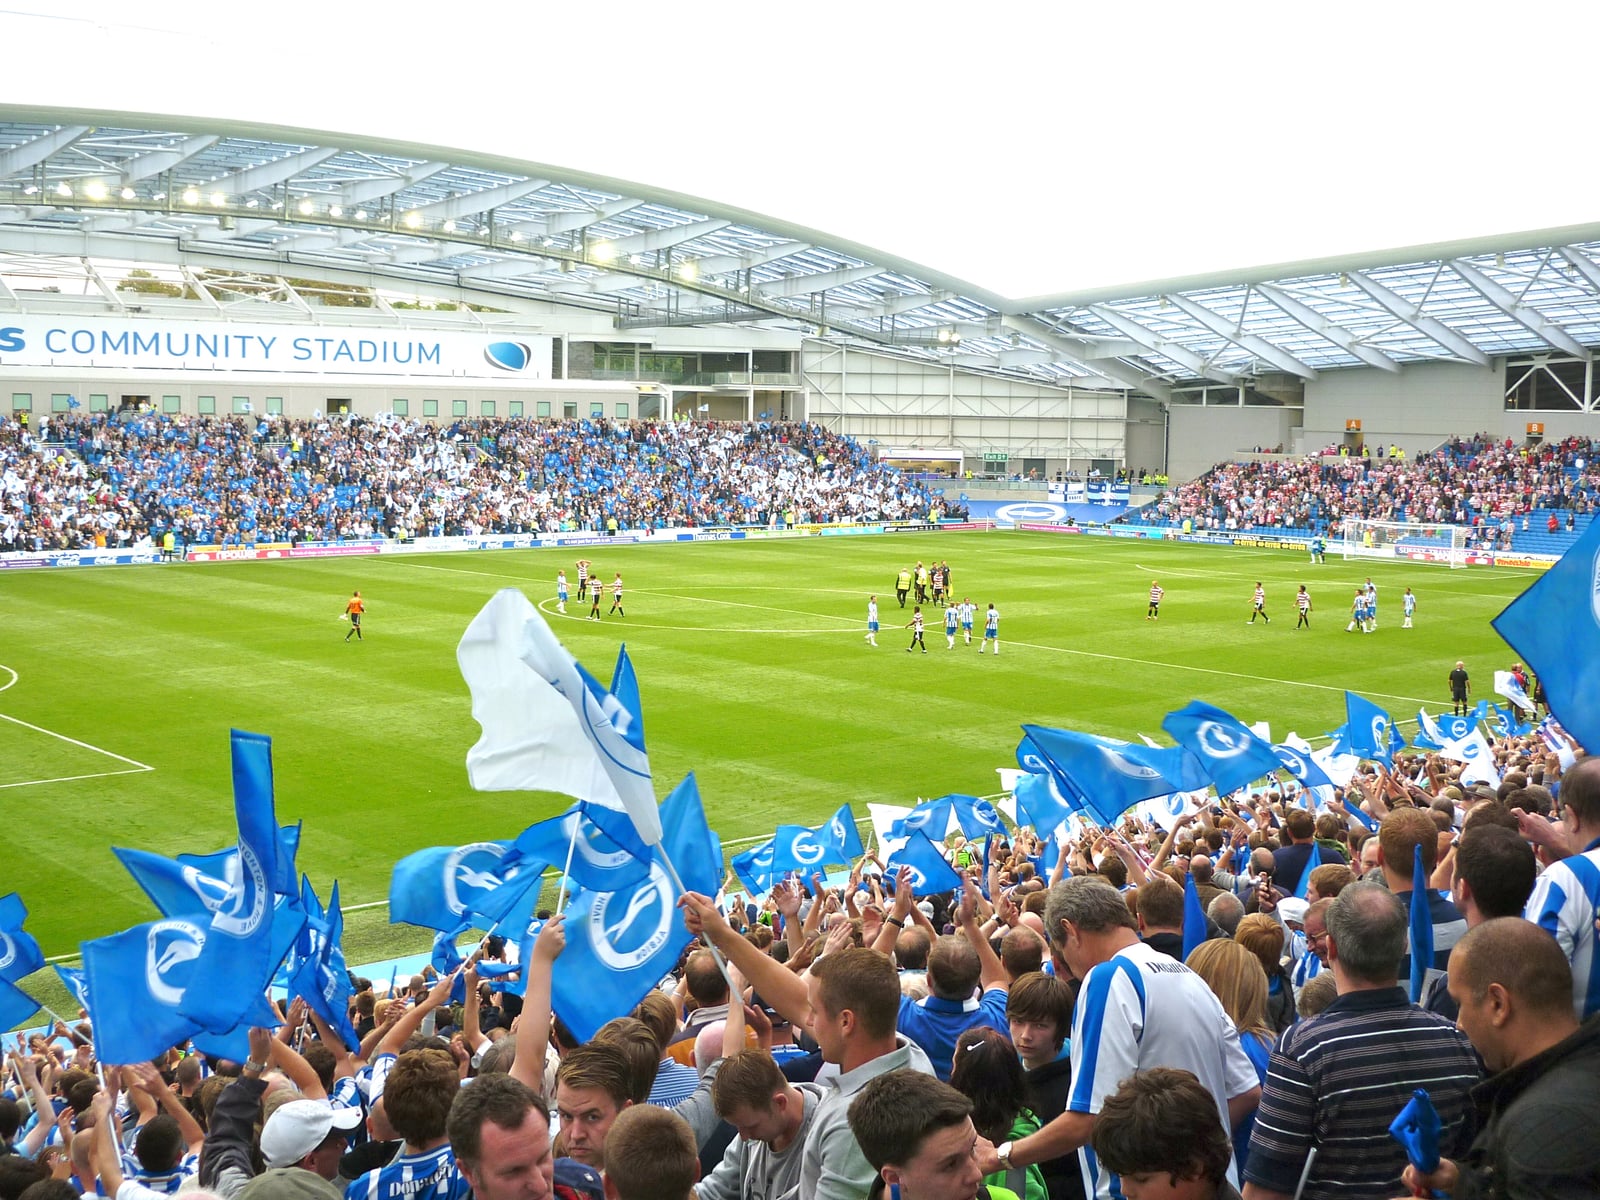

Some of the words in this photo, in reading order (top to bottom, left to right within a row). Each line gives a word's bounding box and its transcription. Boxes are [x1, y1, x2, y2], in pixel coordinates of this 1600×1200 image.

[45, 328, 276, 360] COMMUNITY
[293, 338, 441, 365] STADIUM
[216, 550, 260, 561] npower
